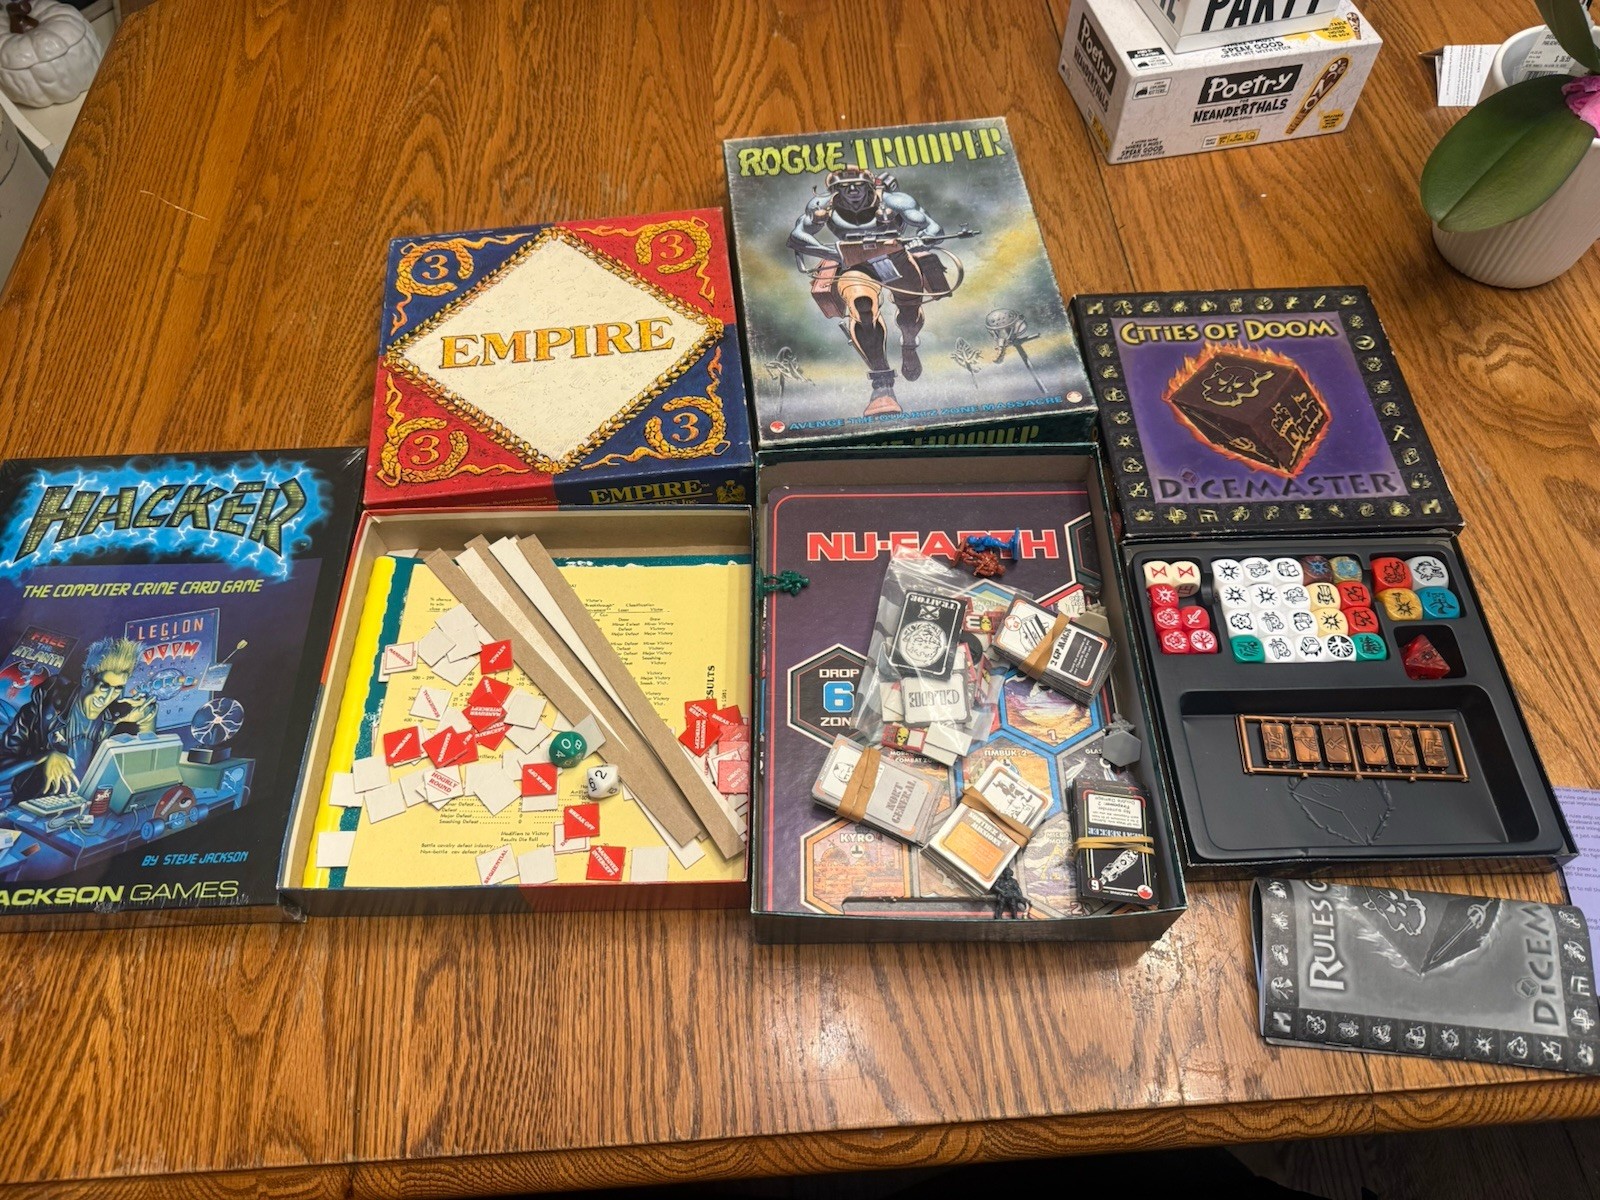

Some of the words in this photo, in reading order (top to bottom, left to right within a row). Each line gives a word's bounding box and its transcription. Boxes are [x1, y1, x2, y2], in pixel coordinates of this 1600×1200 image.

[1081, 19, 1113, 83] Poetry
[1221, 46, 1248, 55] SPEAK
[1254, 41, 1284, 51] GOOD
[1208, 73, 1293, 102] Poetry
[1193, 98, 1288, 123] NEANDERTHALS
[738, 141, 845, 176] ROGUE
[851, 127, 1006, 171] TROOPER
[1121, 149, 1141, 157] SPEAK
[1143, 145, 1163, 154] GOOD
[659, 234, 684, 260] 3
[421, 255, 449, 280] 3
[1200, 321, 1239, 341] OF
[1244, 319, 1338, 341] DOOM
[438, 316, 675, 370] EMPIRE
[789, 418, 845, 431] AVENGE
[850, 415, 876, 424] THE
[879, 409, 938, 422] QUARTZ
[940, 406, 978, 417] ZONE
[983, 395, 1063, 411] MASSACRE
[672, 412, 700, 441] 3
[410, 434, 441, 465] 3
[588, 480, 703, 505] EMPIRE
[13, 477, 307, 563] HACKER
[23, 585, 52, 598] THE
[53, 583, 131, 598] COMPUTER
[133, 581, 177, 596] CRIME
[180, 580, 219, 594] CARD
[221, 579, 265, 593] GAME
[910, 594, 957, 611] TRAITOR
[31, 633, 67, 648] FREE
[138, 618, 204, 640] LEGION
[37, 643, 53, 652] THE
[143, 641, 201, 665] DOOM
[488, 645, 507, 665] ATTACK
[1053, 648, 1062, 660] GP
[1060, 628, 1072, 650] MAGS
[12, 645, 65, 668] ATLANTA
[389, 647, 411, 665] MANEUVER
[706, 665, 715, 700] ESULTS
[819, 669, 860, 678] DROP
[423, 690, 440, 718] SEQUENTIAL
[823, 681, 855, 713] 6
[909, 689, 960, 708] CLUE
[820, 717, 855, 727] ZON
[389, 732, 413, 758] BOMBARD
[575, 739, 582, 750] 8
[1047, 729, 1056, 740] 1
[556, 750, 565, 758] 4
[429, 778, 452, 793] ROUND
[431, 772, 458, 789] HOURLY
[537, 777, 552, 791] BREAK
[595, 770, 607, 780] 2
[886, 782, 903, 811] NORT
[891, 779, 917, 823] GENERAL
[568, 808, 585, 824] BREAK
[584, 821, 596, 831] OFF
[840, 833, 875, 843] KYRO
[141, 855, 159, 866] BY
[163, 853, 198, 865] STEVE
[199, 851, 249, 864] JACKSON
[484, 850, 508, 884] SEQUENTIAL
[592, 850, 615, 876] INTERCEPT
[596, 846, 619, 873] MANEUVER
[0, 885, 125, 906] ACKSON
[129, 880, 239, 902] GAMES
[1070, 901, 1083, 914] 2
[1309, 899, 1345, 991] RULES
